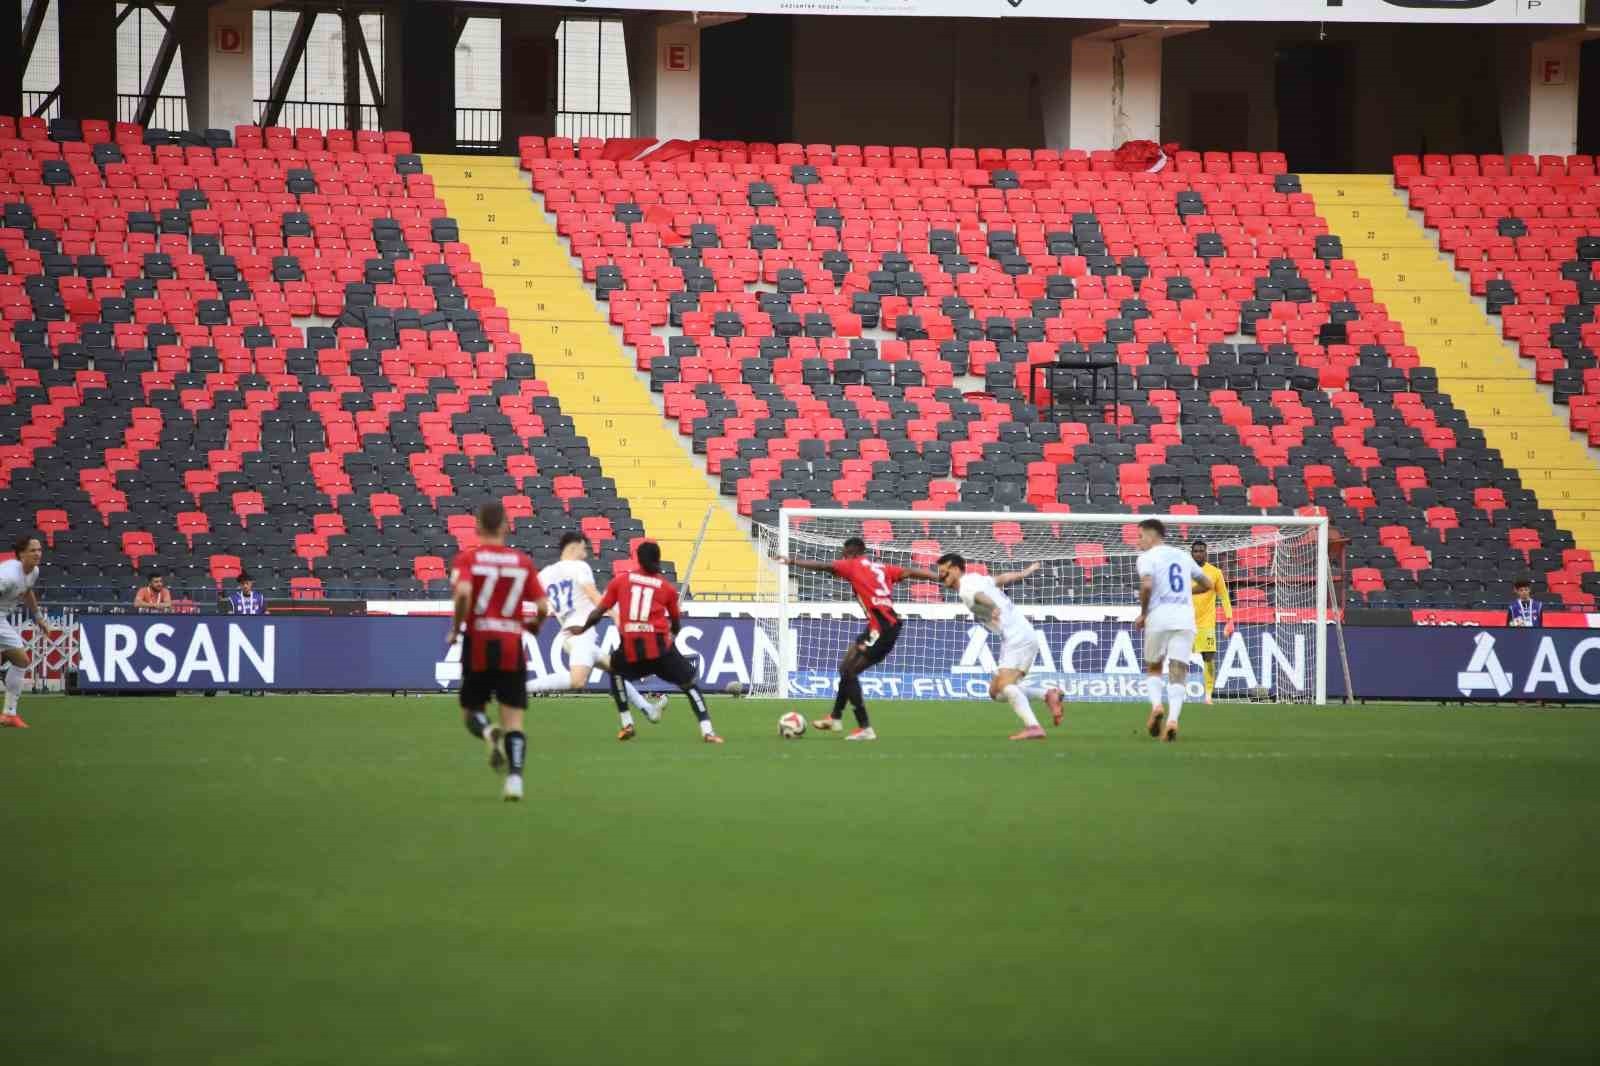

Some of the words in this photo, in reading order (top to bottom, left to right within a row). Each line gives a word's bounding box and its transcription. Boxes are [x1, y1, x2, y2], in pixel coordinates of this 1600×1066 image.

[221, 30, 240, 50] D
[670, 47, 684, 68] E
[1545, 61, 1560, 82] F
[471, 564, 528, 618] 77
[1169, 562, 1184, 593] 6
[547, 579, 573, 613] 37
[629, 584, 655, 621] 11
[1523, 635, 1600, 696] AC
[1040, 675, 1205, 698] suratkao
